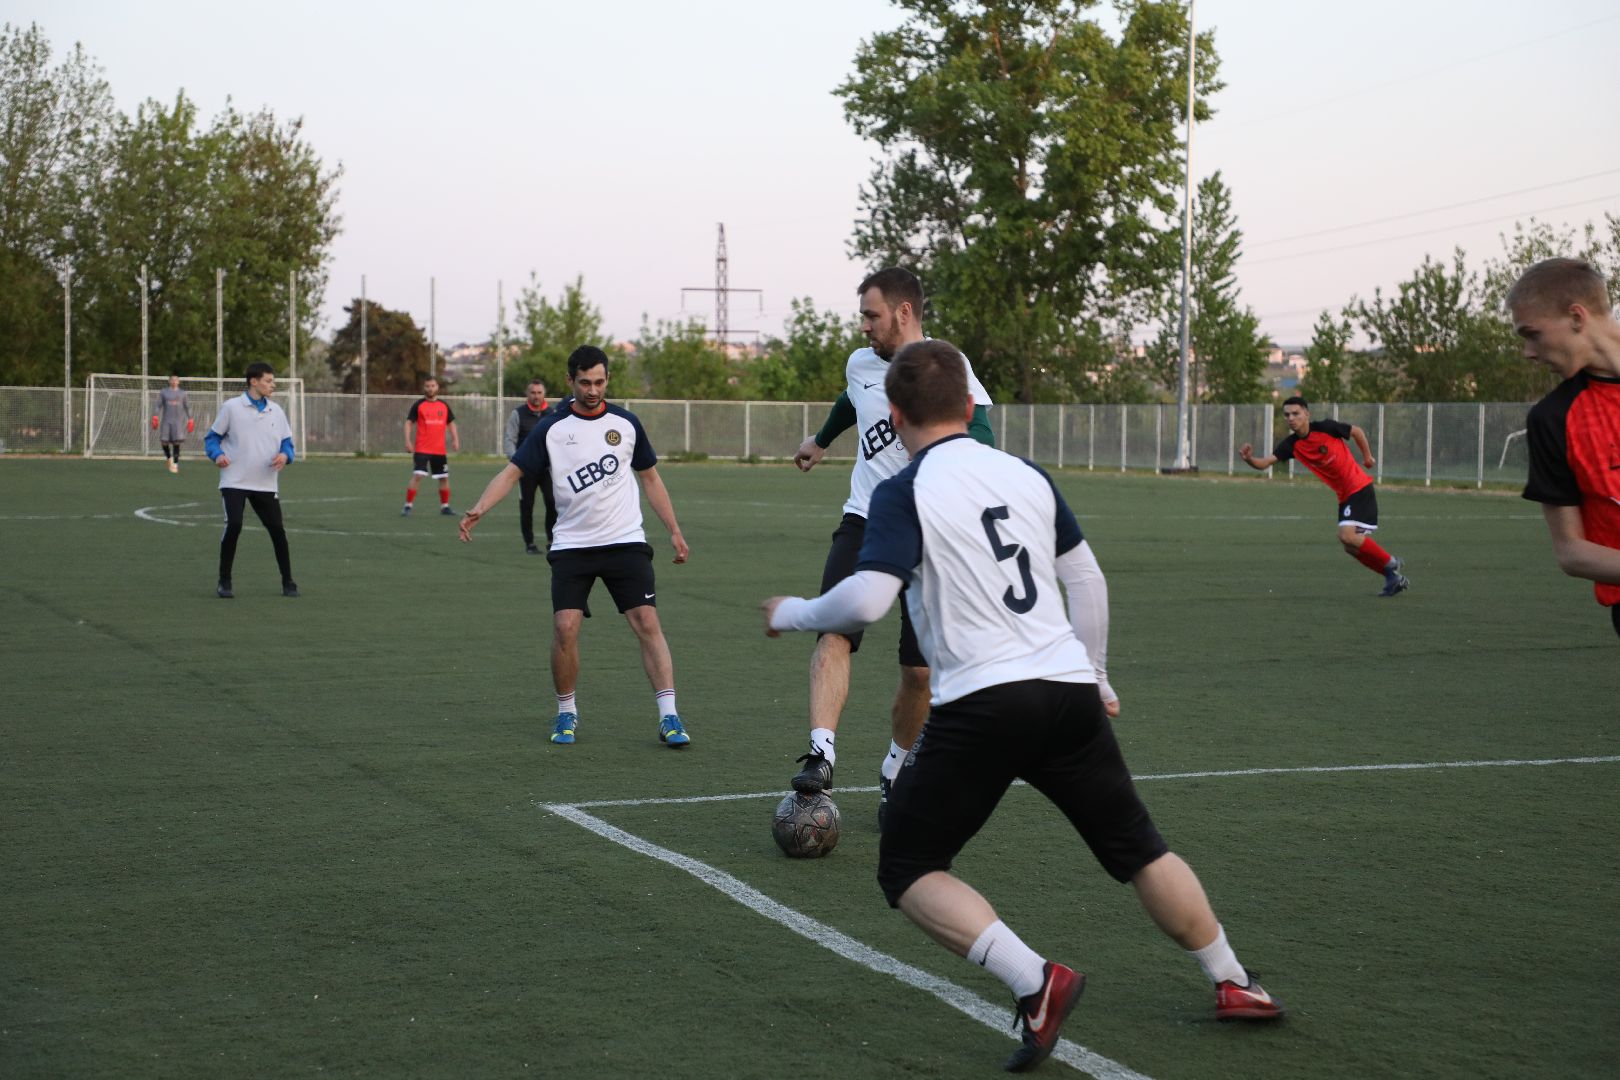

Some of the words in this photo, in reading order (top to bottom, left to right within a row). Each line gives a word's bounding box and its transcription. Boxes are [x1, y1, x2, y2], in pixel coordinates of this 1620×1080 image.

[861, 413, 896, 461] LEB
[567, 454, 619, 493] LEBO
[1343, 505, 1351, 517] 6
[981, 505, 1038, 615] 5
